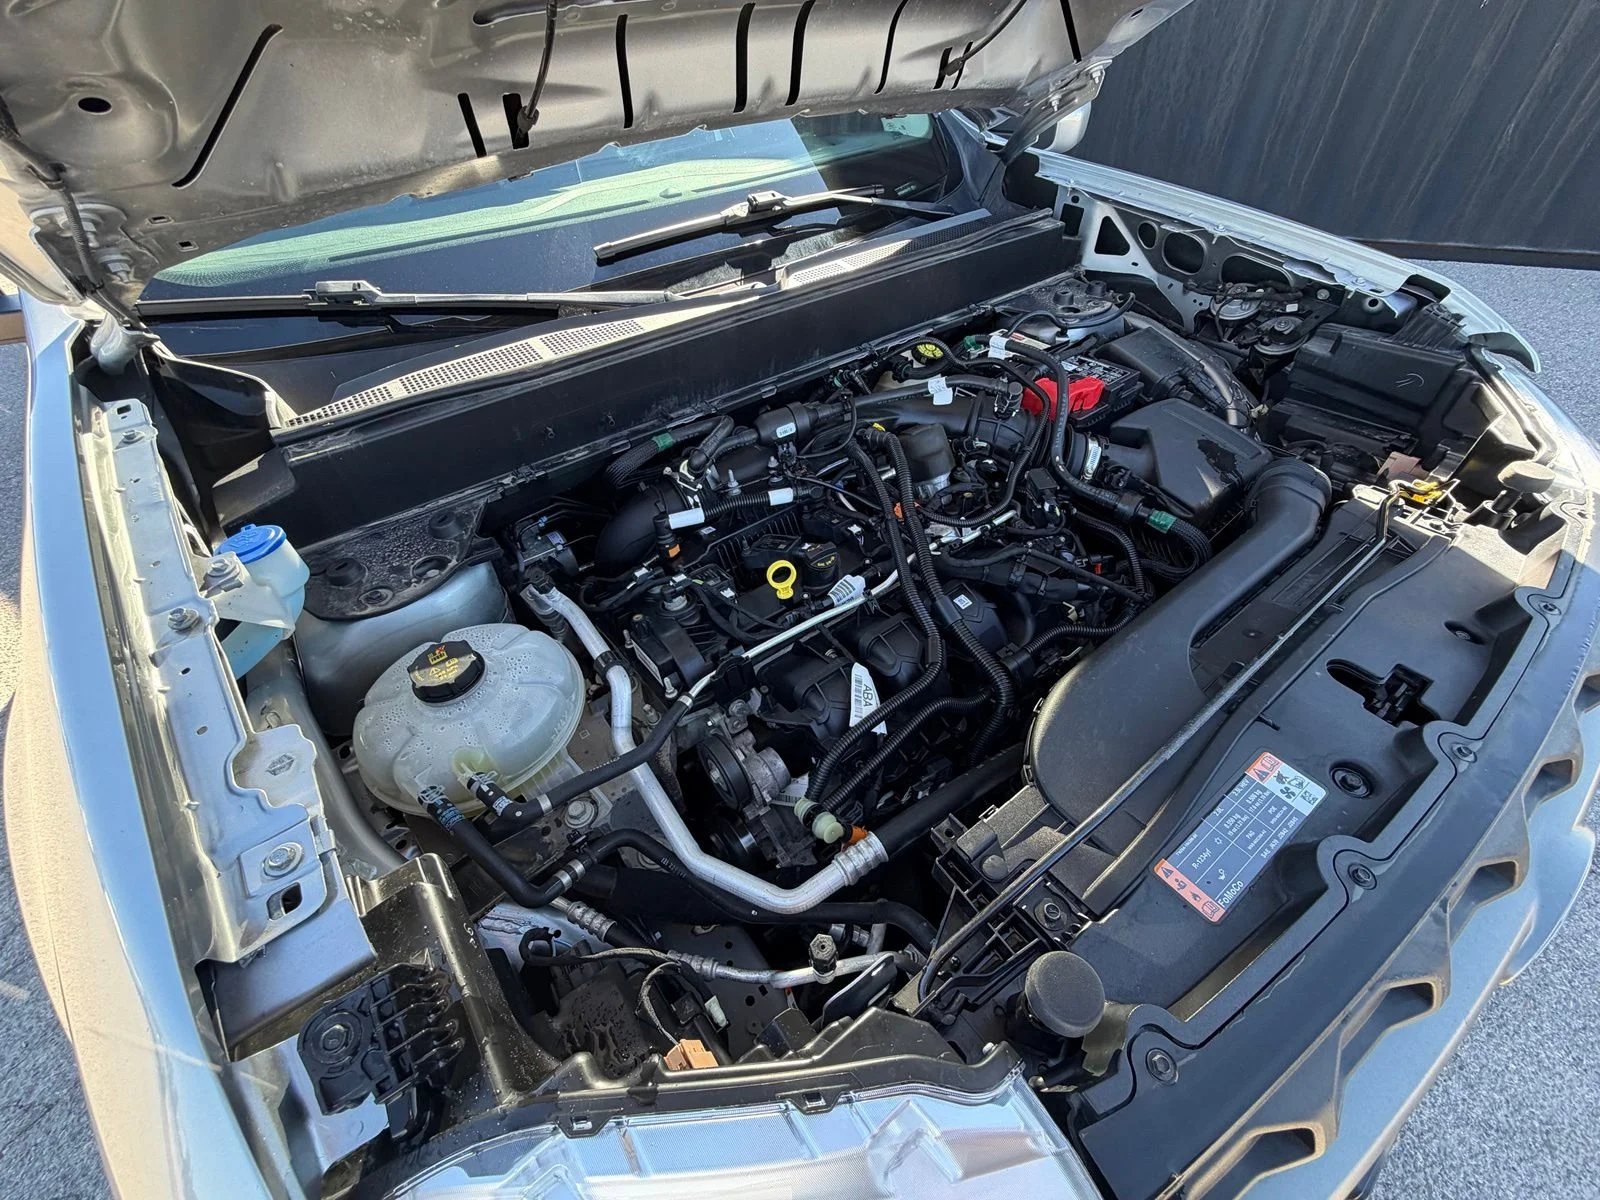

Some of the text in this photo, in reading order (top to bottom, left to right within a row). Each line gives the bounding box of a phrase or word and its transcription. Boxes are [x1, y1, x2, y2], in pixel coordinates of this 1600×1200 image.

[862, 684, 874, 707] ABA
[1240, 778, 1250, 788] HEV
[1191, 848, 1212, 870] R-1234yf
[1217, 880, 1244, 908] FoMoCo
